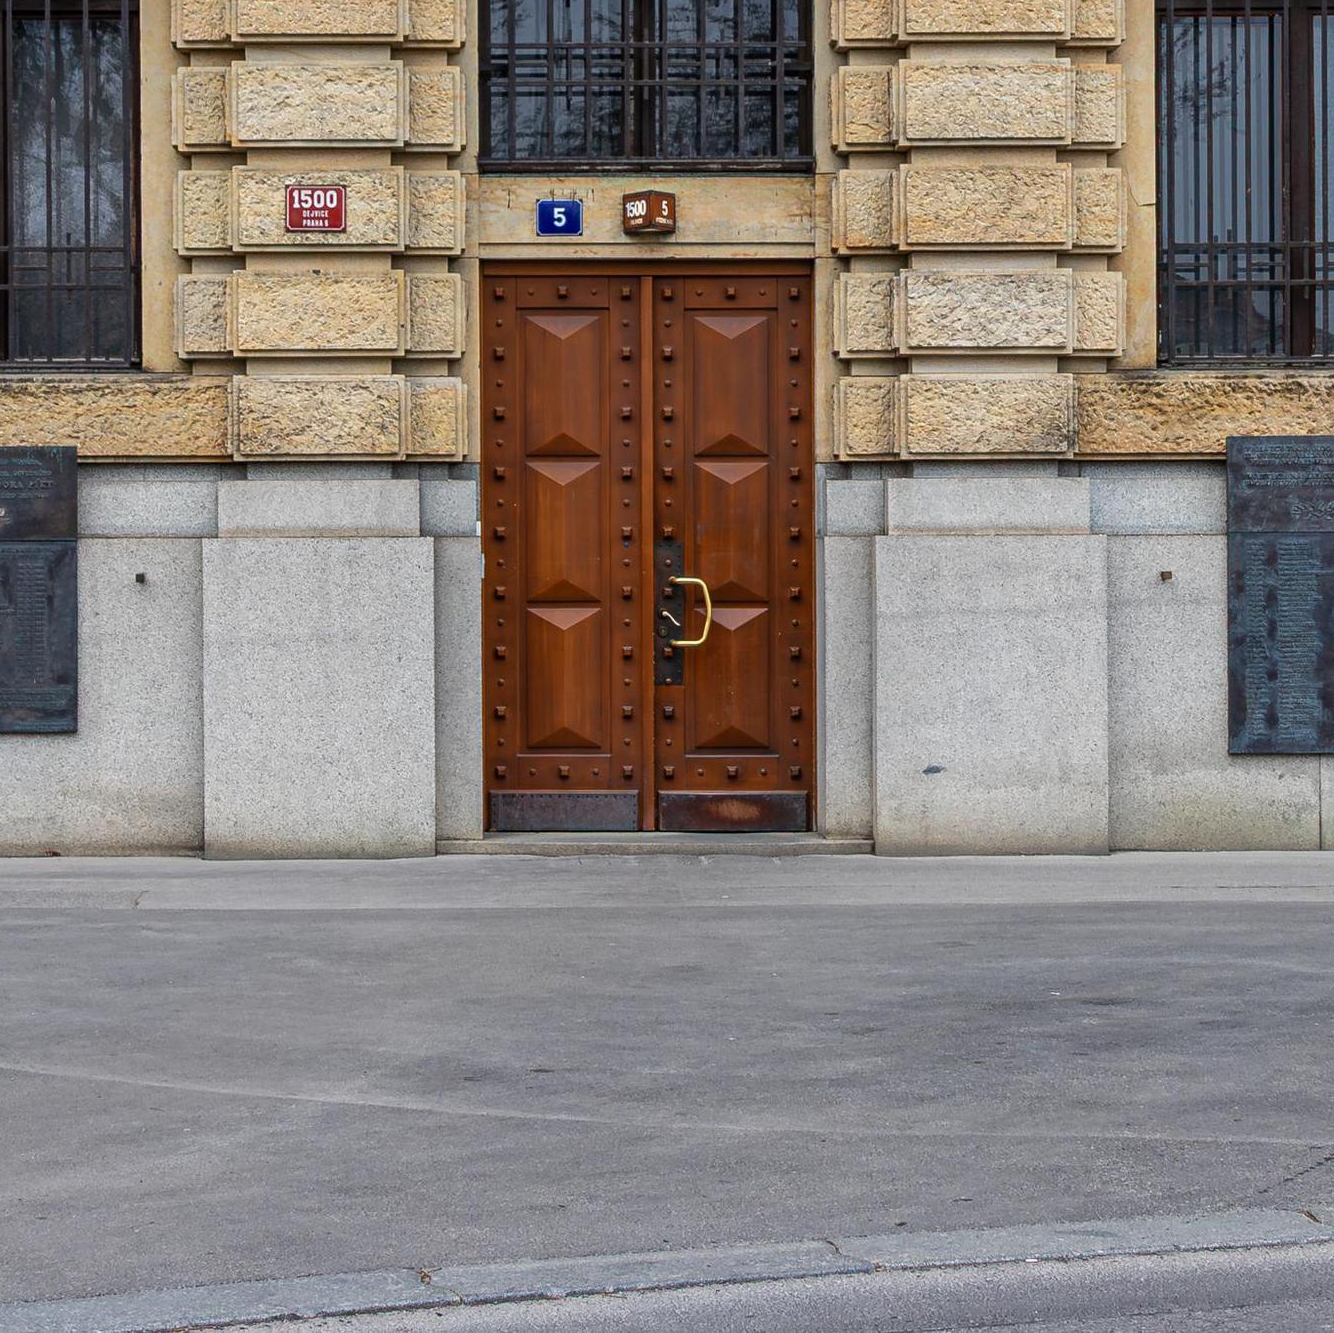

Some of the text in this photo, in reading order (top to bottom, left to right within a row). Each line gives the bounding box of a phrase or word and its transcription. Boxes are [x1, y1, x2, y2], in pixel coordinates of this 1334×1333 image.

[292, 189, 337, 208] 1500
[302, 210, 329, 218] DEJVICE
[625, 199, 647, 218] 1500
[661, 200, 669, 216] 5
[302, 219, 324, 227] PRAHA
[553, 207, 567, 227] 5
